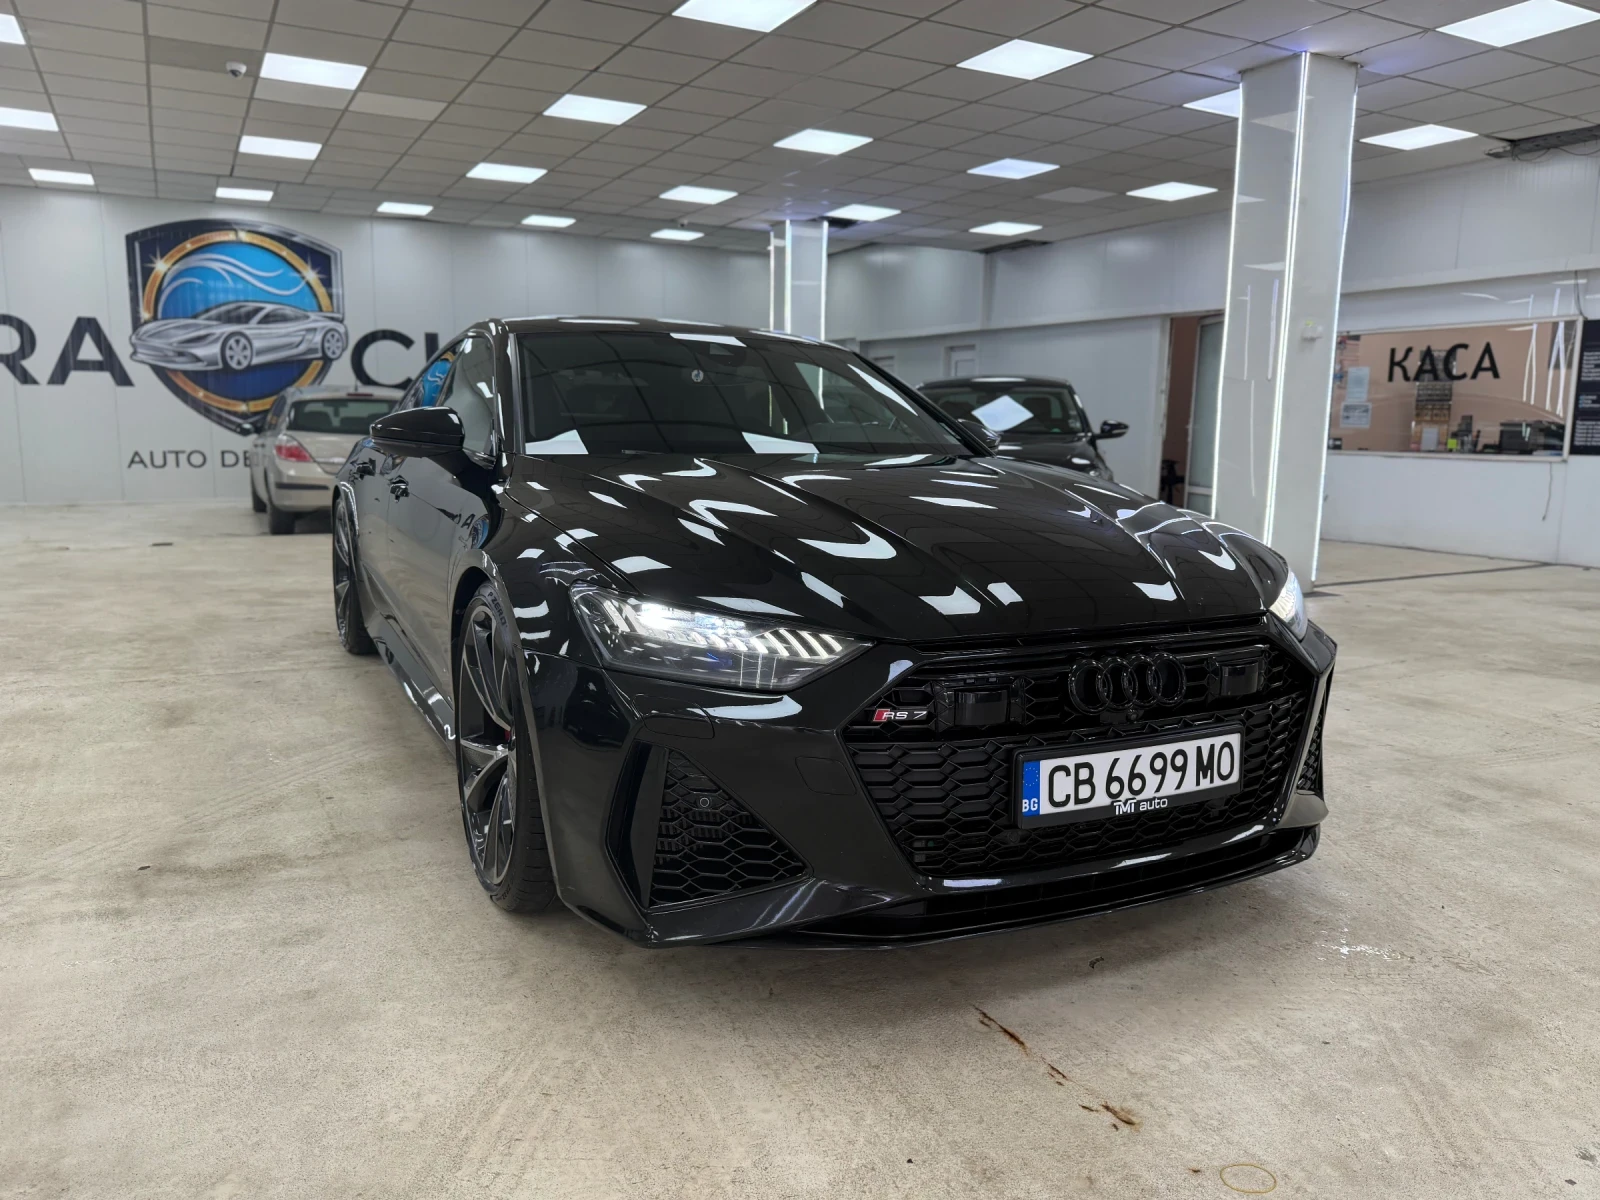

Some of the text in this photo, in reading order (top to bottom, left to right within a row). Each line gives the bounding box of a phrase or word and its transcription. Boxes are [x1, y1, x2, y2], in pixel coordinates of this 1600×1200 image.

[1387, 342, 1500, 382] КАСА
[127, 449, 207, 469] AUTO
[882, 711, 928, 720] RS 7
[1048, 740, 1235, 809] CB 6699 MO
[1022, 797, 1039, 813] BG
[1139, 797, 1168, 811] auto
